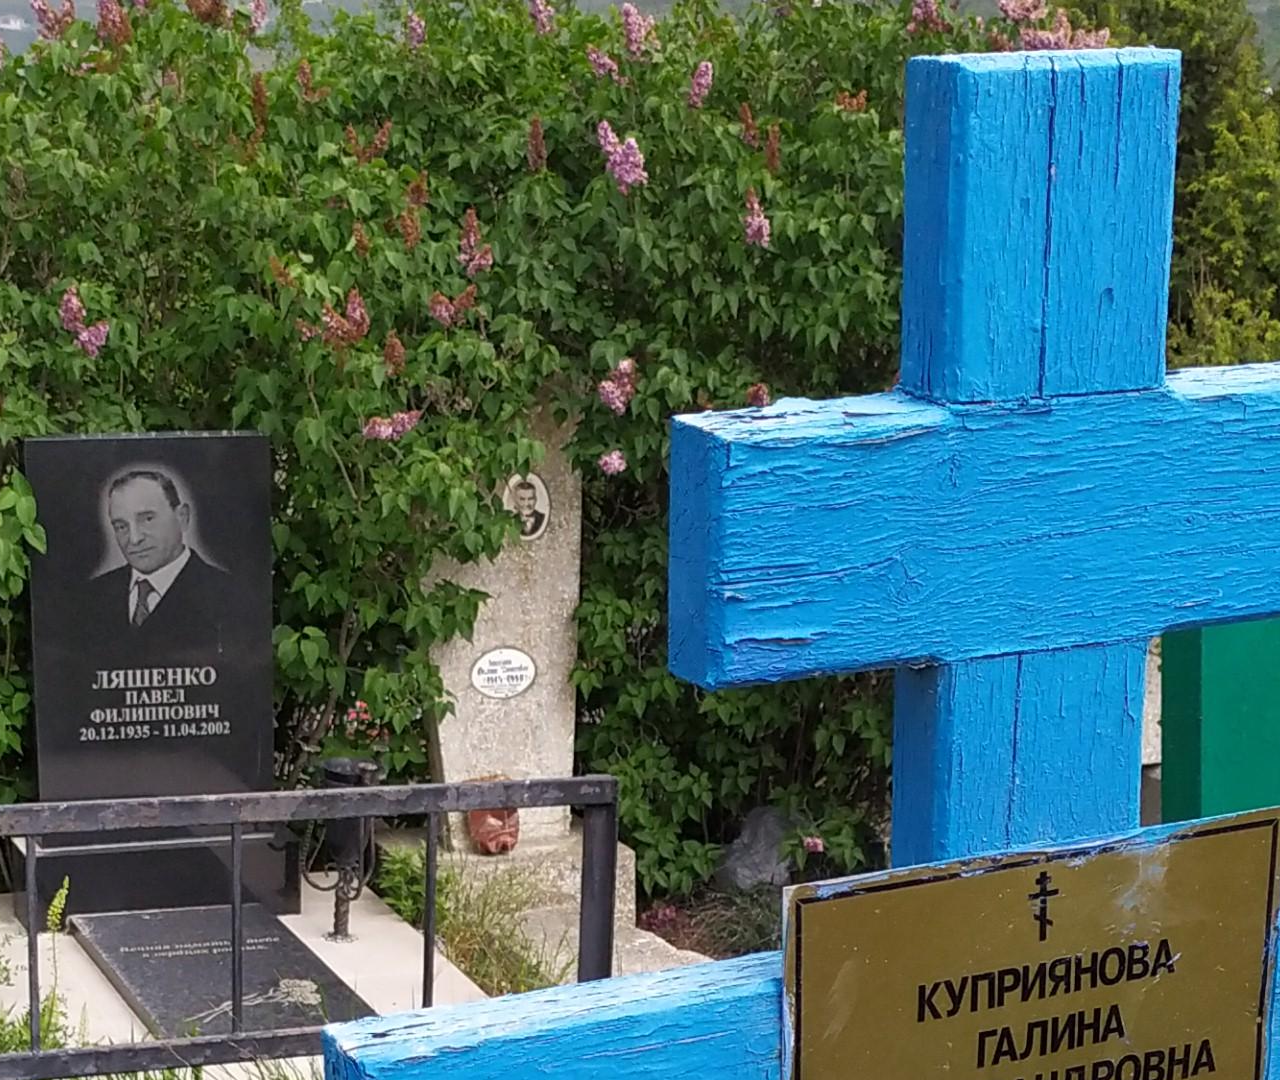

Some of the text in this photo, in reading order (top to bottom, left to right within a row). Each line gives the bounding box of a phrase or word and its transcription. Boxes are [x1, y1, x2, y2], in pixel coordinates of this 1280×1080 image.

[92, 666, 217, 690] ЛЯШЕНКО
[125, 688, 185, 705] ПАВЕЛ
[90, 704, 220, 724] ФИЛИППОВИЧ
[79, 726, 150, 741] 20.12.1935
[163, 721, 231, 737] 11.04.2002
[916, 939, 1175, 1022] КУПРИЯНОВА
[977, 1004, 1125, 1069] ГАЛИНА
